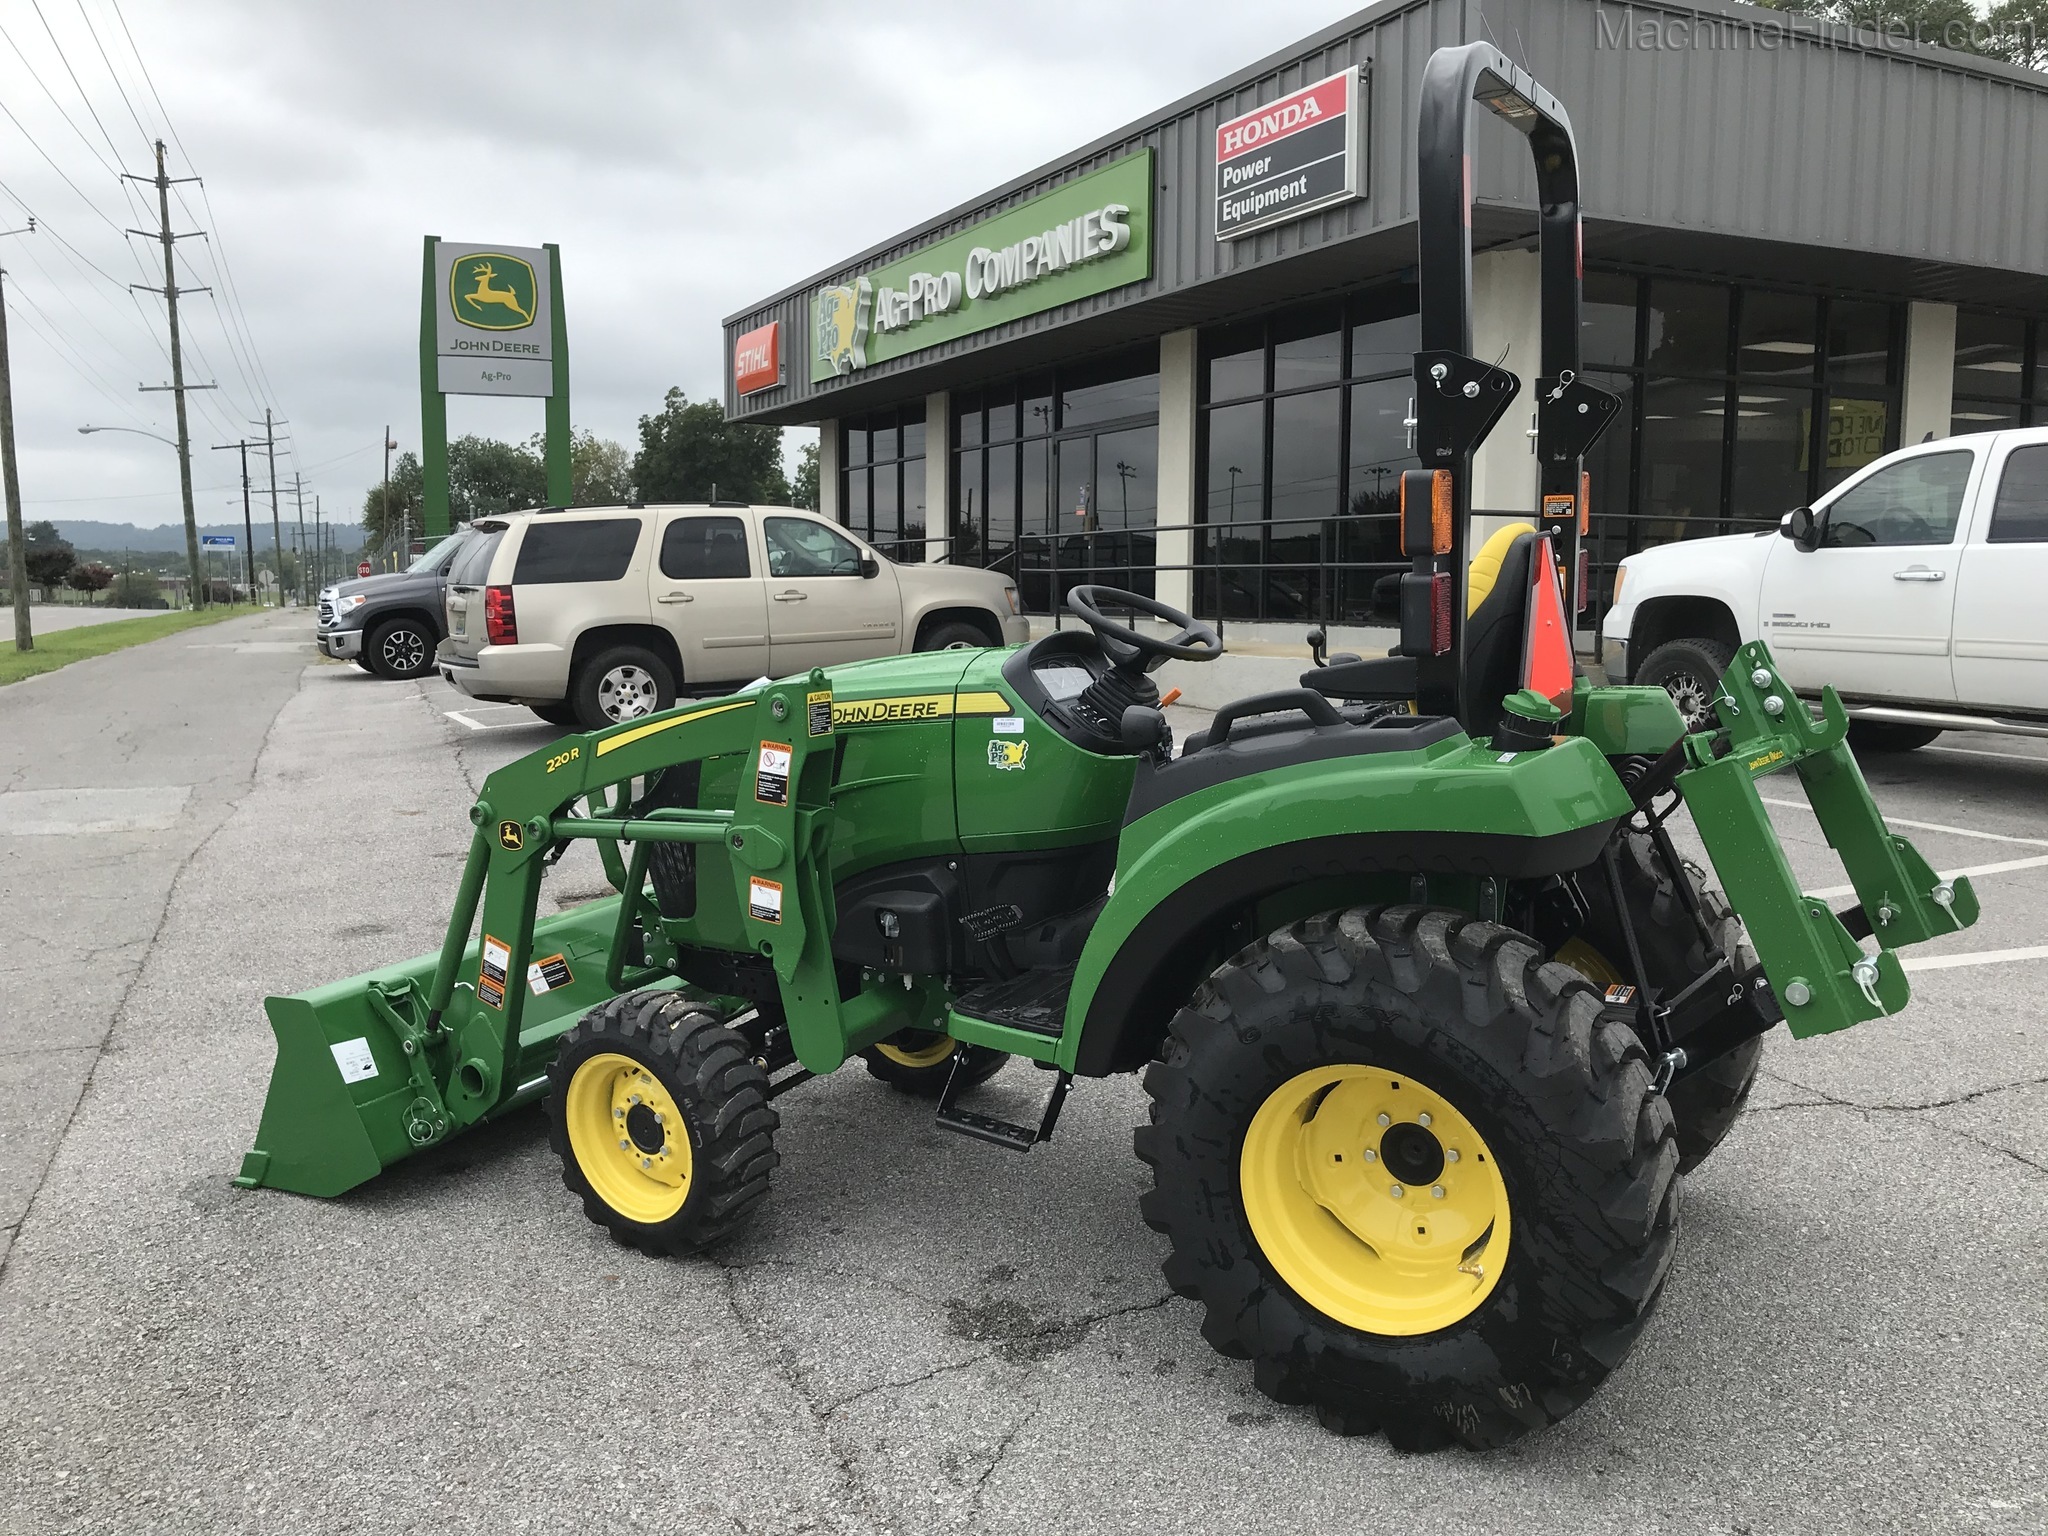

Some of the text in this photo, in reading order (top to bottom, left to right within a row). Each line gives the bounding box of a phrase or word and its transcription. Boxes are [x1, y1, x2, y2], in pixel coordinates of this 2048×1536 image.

[1223, 96, 1322, 154] HONDA
[1223, 156, 1272, 189] Power
[1222, 174, 1307, 222] Equipment
[965, 203, 1131, 300] COMPANIES
[450, 338, 540, 354] JOHN DEERE
[736, 343, 769, 378] STIHL
[481, 371, 512, 382] Ag-Pro
[358, 566, 371, 574] STO
[832, 706, 869, 722] OHN
[872, 702, 939, 719] DEERE
[990, 742, 1008, 754] Ag-
[990, 752, 1009, 762] Pro
